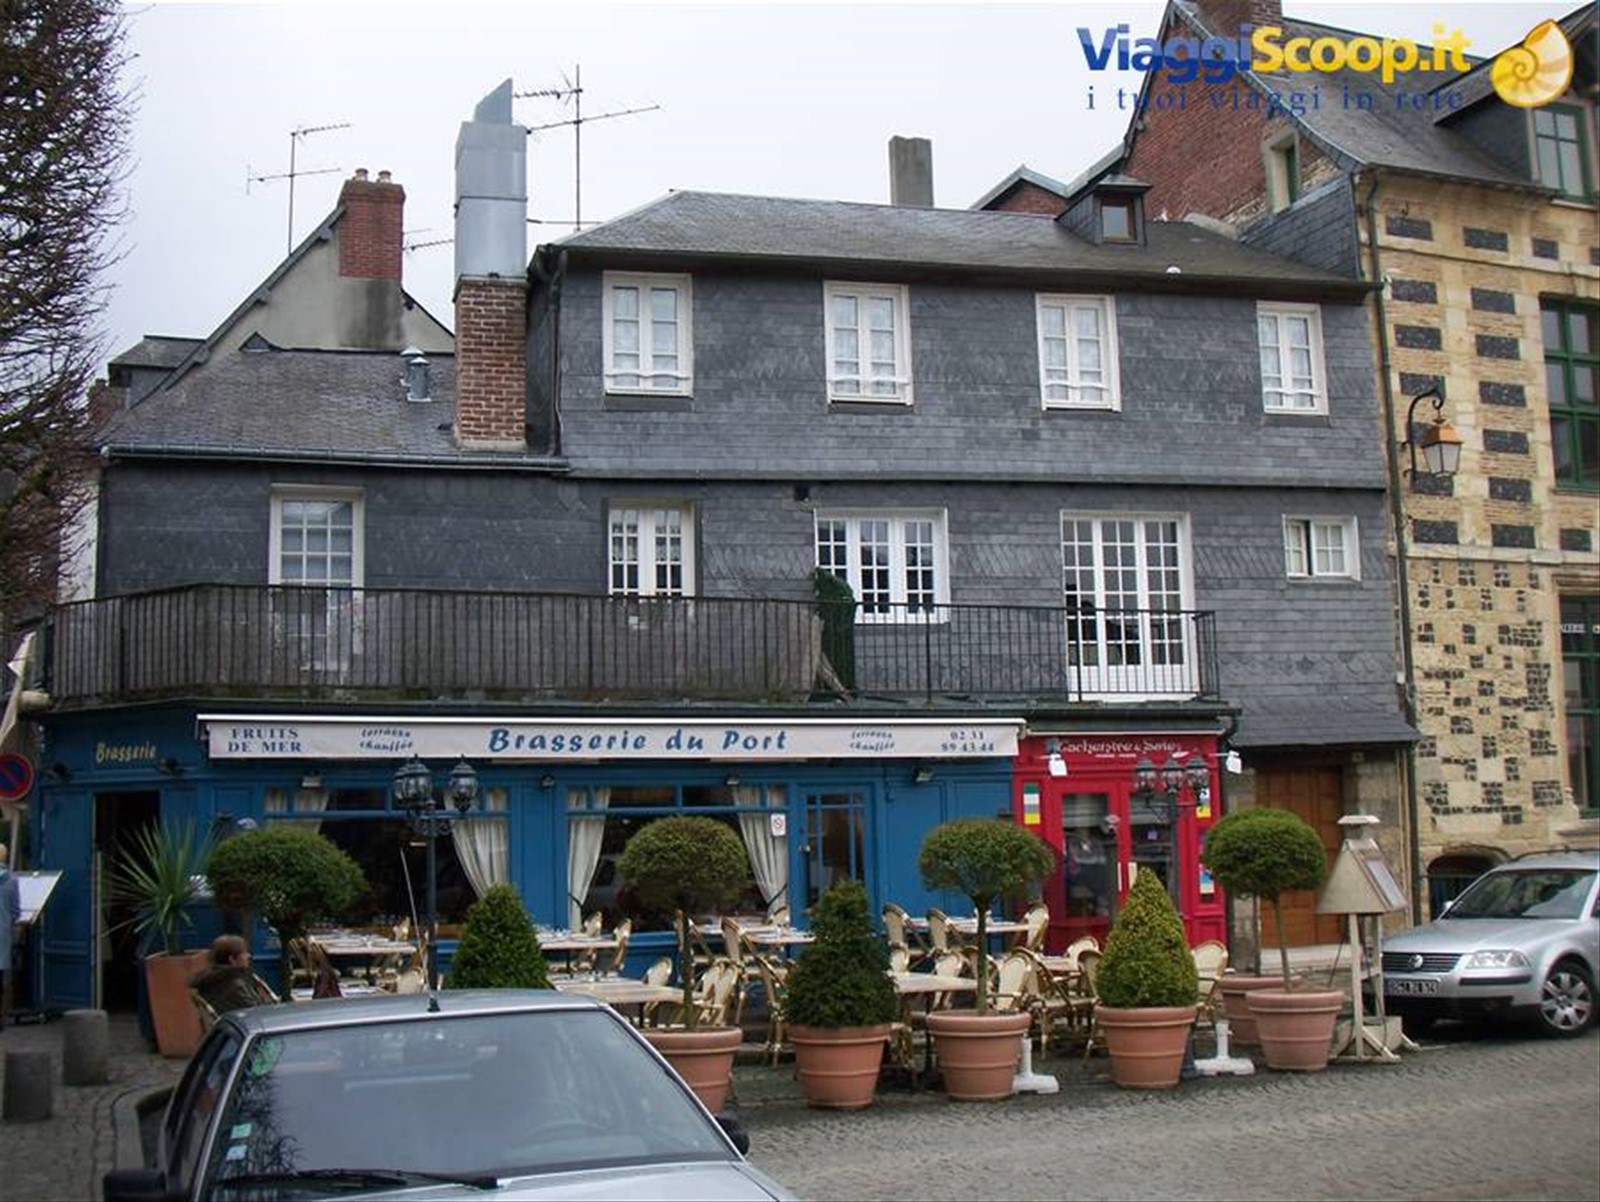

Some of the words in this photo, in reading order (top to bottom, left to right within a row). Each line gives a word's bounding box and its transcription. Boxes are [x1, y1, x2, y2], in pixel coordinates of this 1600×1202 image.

[231, 727, 299, 740] FRUITS
[950, 730, 966, 741] 02
[488, 728, 648, 752] Brasserie
[665, 729, 704, 750] du
[722, 730, 787, 751] Port
[95, 740, 157, 764] Brasserie
[228, 741, 253, 753] DE
[261, 741, 303, 753] MER
[979, 742, 995, 753] 44
